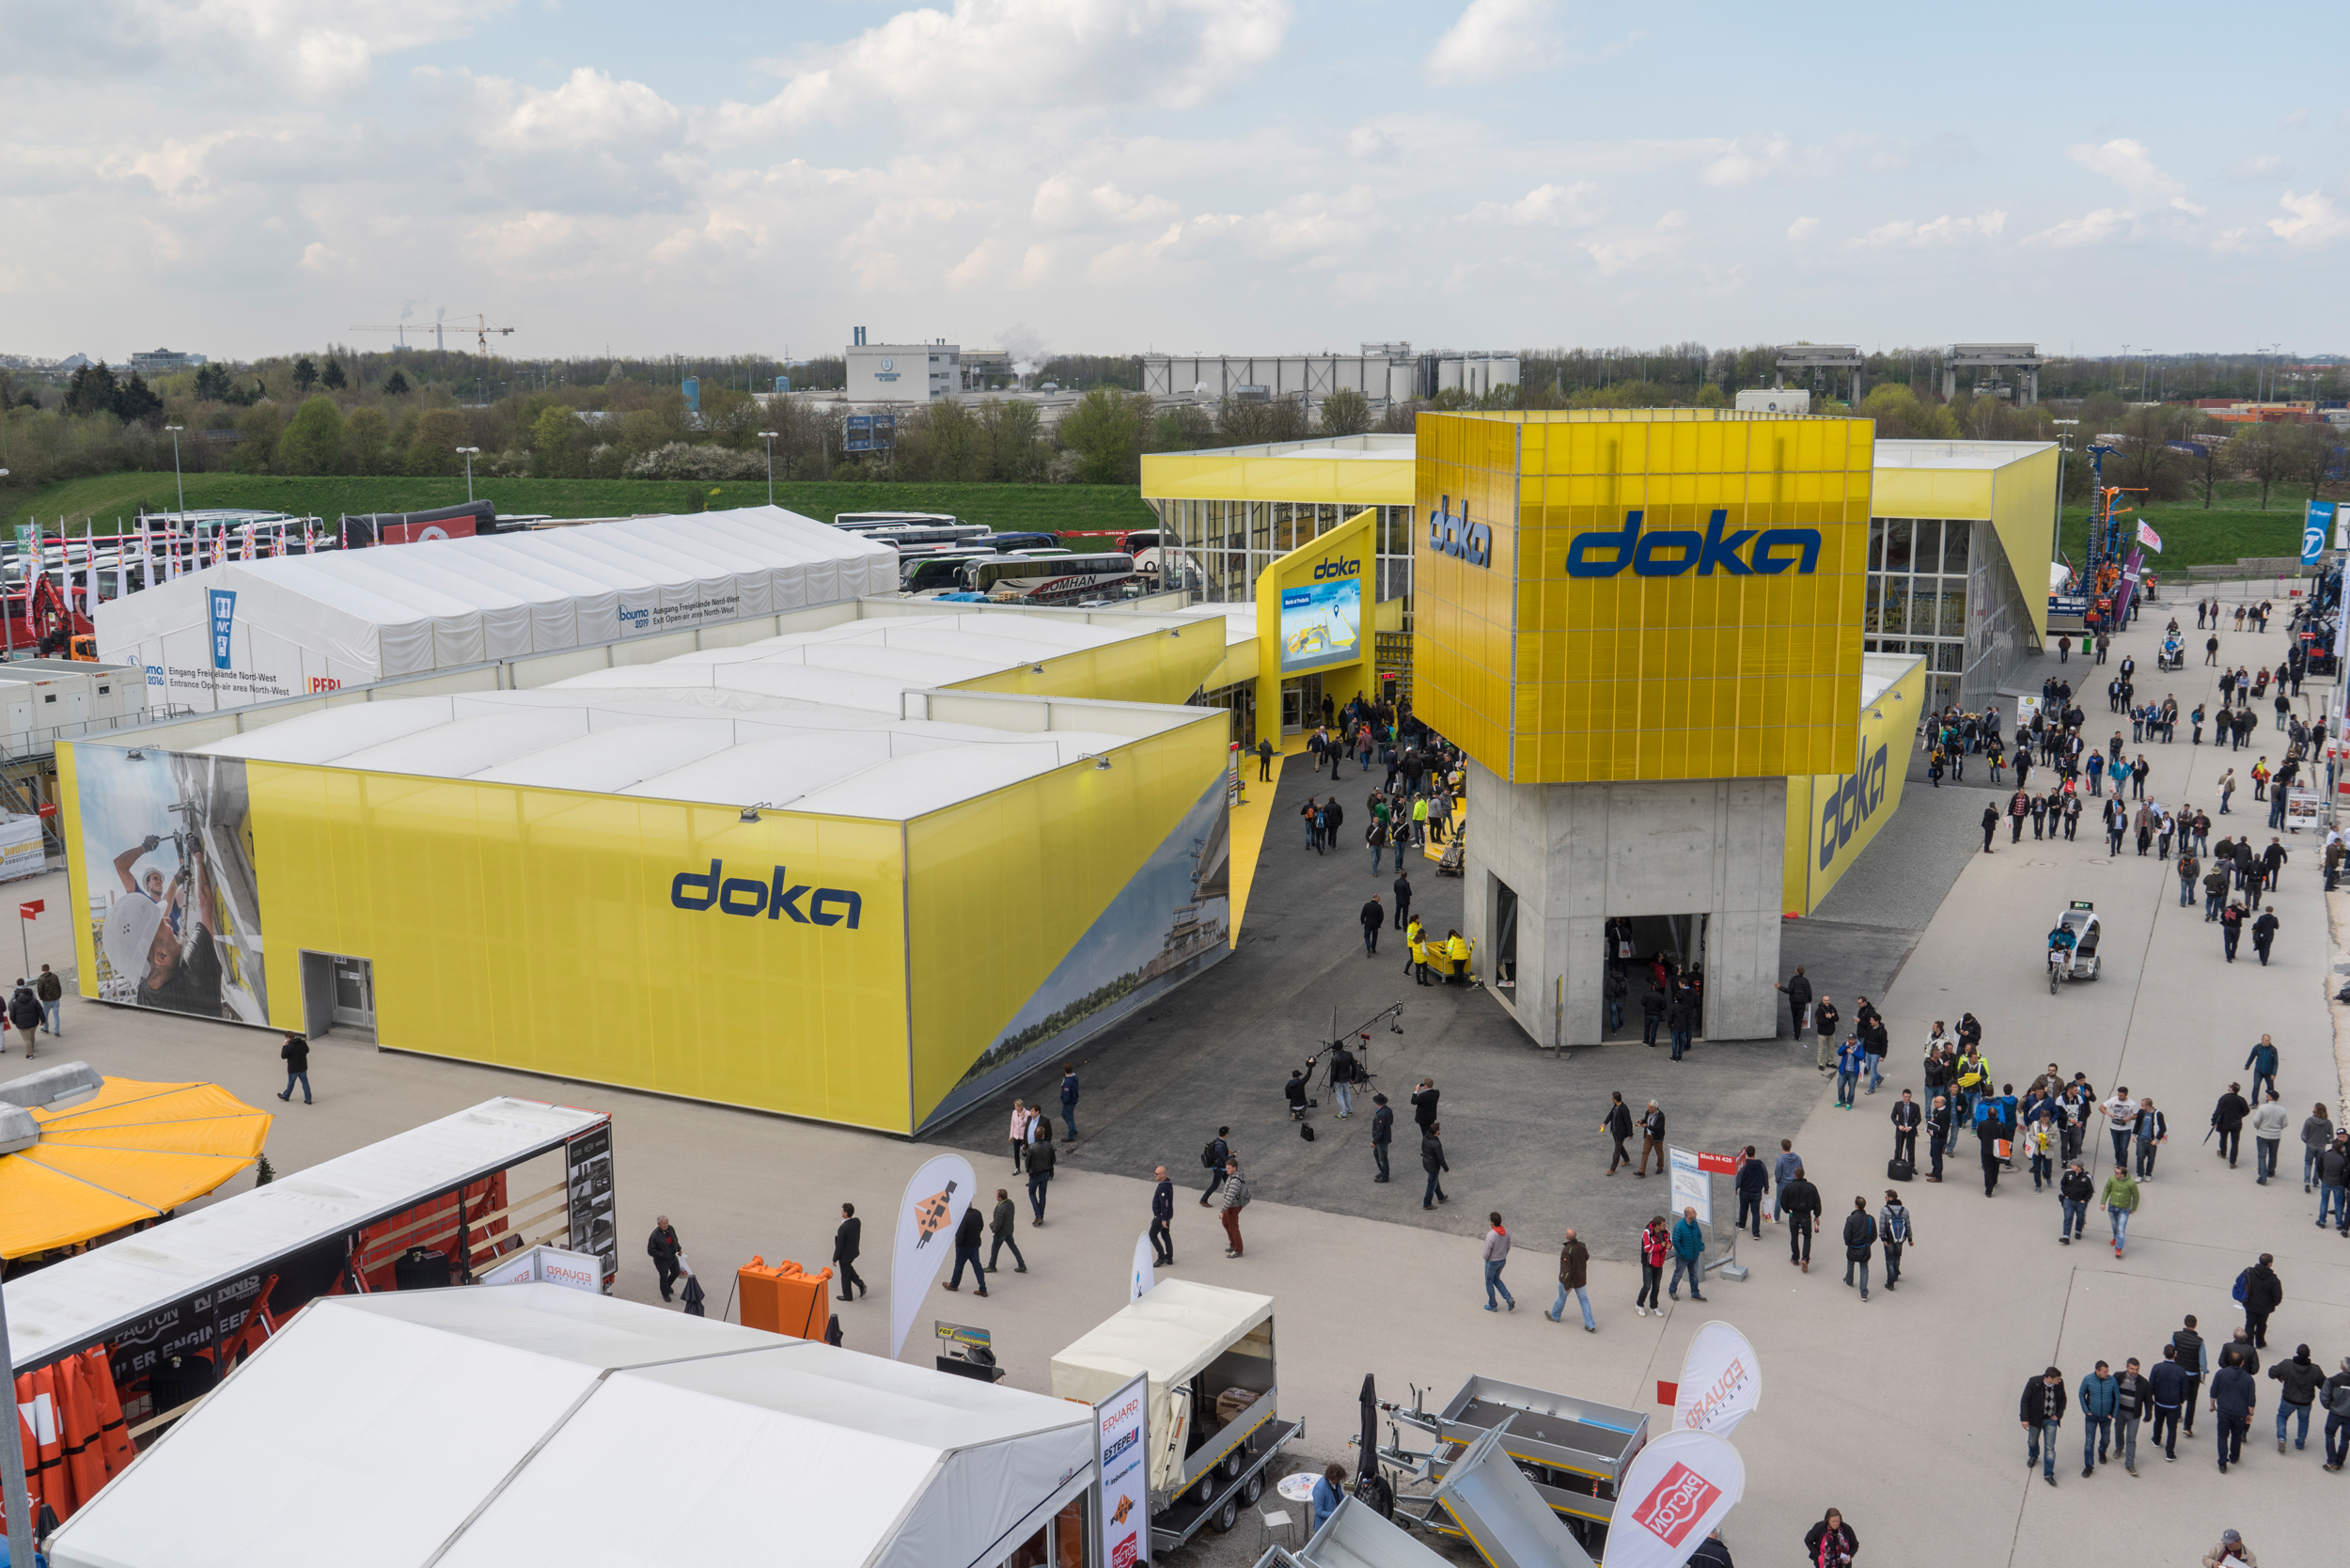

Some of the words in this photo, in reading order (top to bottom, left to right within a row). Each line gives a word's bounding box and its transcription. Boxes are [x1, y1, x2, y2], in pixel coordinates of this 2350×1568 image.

[1430, 494, 1492, 569] doka
[1566, 509, 1822, 578] doka
[1313, 556, 1360, 580] doka
[1041, 575, 1096, 593] DOMHAN
[617, 604, 649, 621] bauma
[653, 604, 679, 616] Ausgang
[680, 600, 711, 612] Freigelände
[712, 596, 740, 606] Nord-West
[653, 617, 665, 625] Exit
[666, 613, 690, 624] Open-air
[704, 606, 735, 617] North-West
[148, 676, 164, 685] 2016
[169, 666, 196, 679] Eingang
[239, 670, 276, 682] Nord-West
[170, 679, 200, 689] Entrance
[250, 684, 290, 697] North-West
[1819, 734, 1888, 872] doka
[5, 852, 42, 865] construction
[670, 858, 862, 930] doka
[1700, 1153, 1715, 1162] Block
[236, 1286, 261, 1302] TRAILERS
[1103, 1399, 1139, 1432] EDUARD
[1112, 1542, 1137, 1567] PACTON
